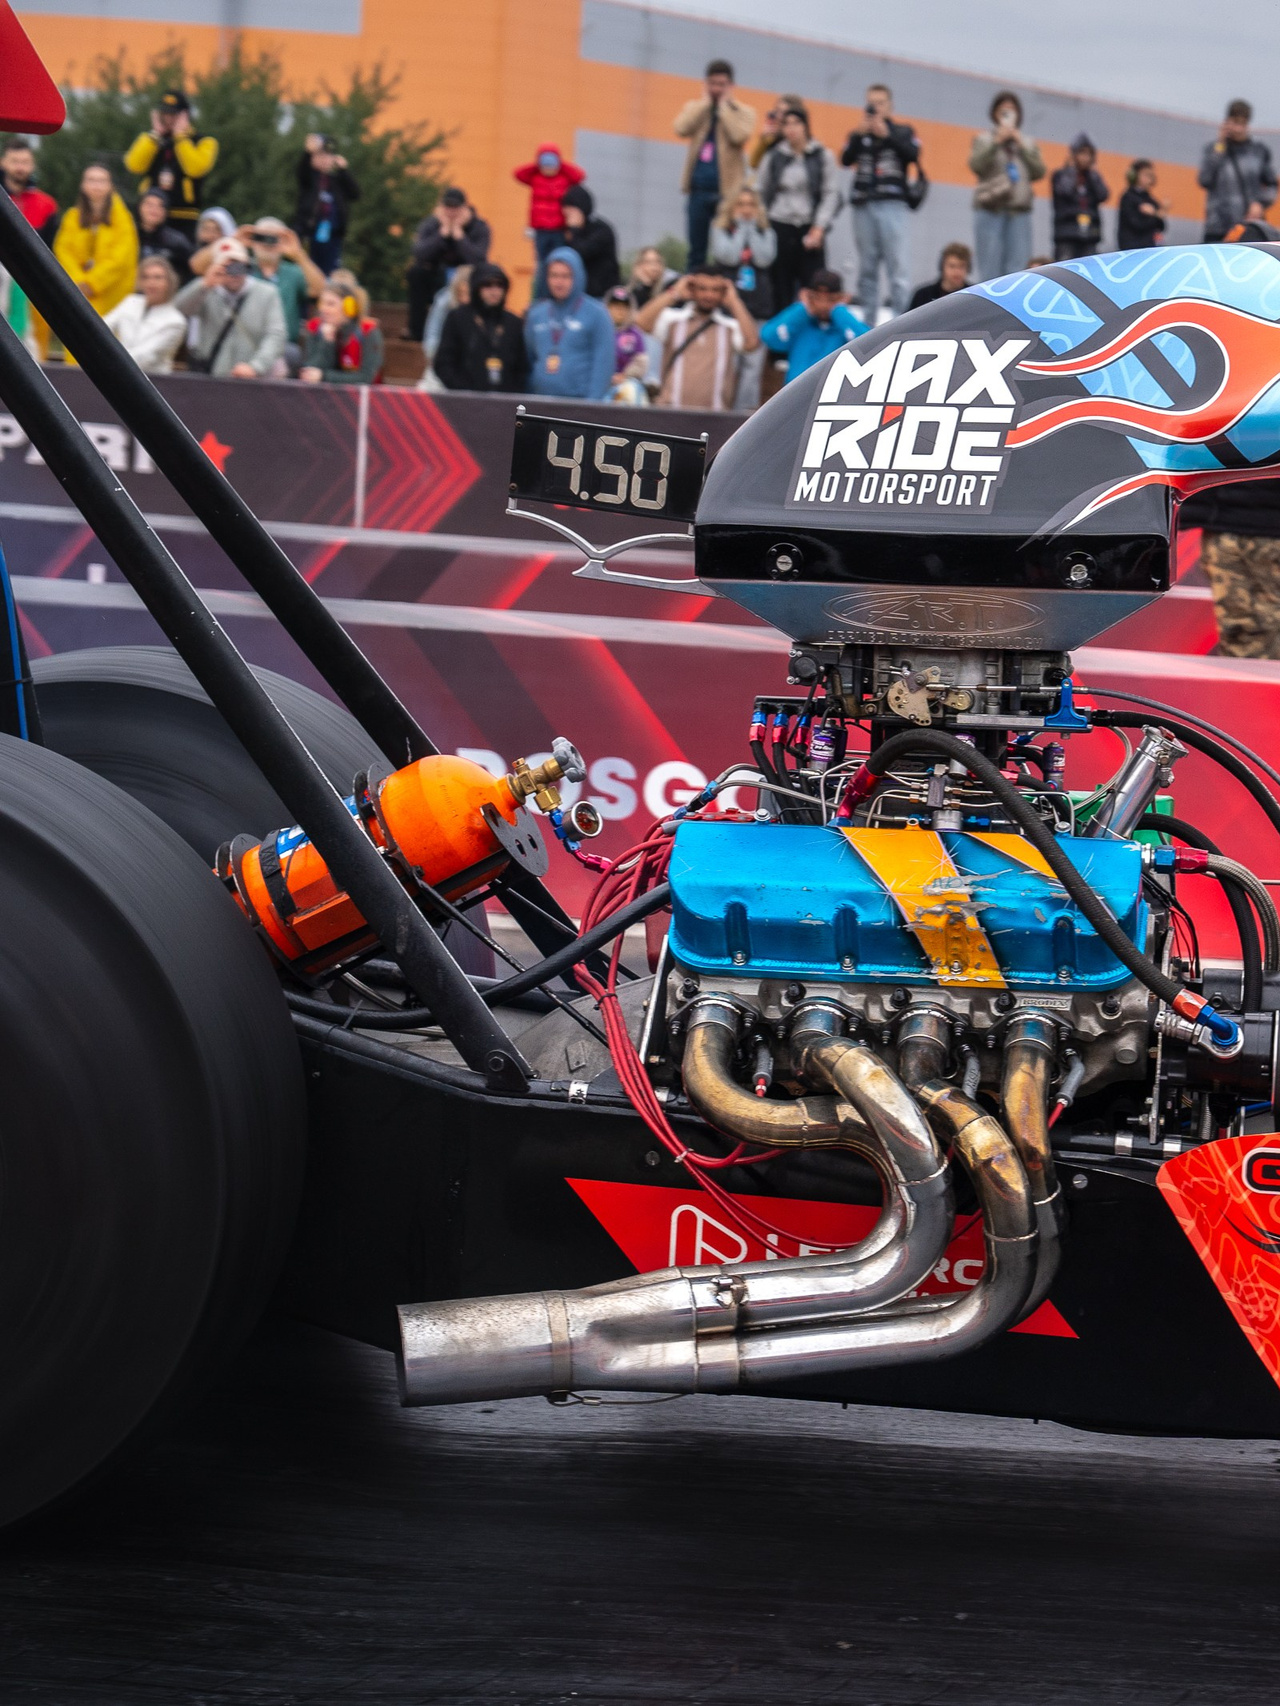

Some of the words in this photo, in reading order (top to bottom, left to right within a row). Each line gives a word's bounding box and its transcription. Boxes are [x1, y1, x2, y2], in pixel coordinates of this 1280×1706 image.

[818, 339, 1032, 405] MAX
[547, 430, 671, 510] 4.50
[793, 471, 998, 507] MOTORSPORT
